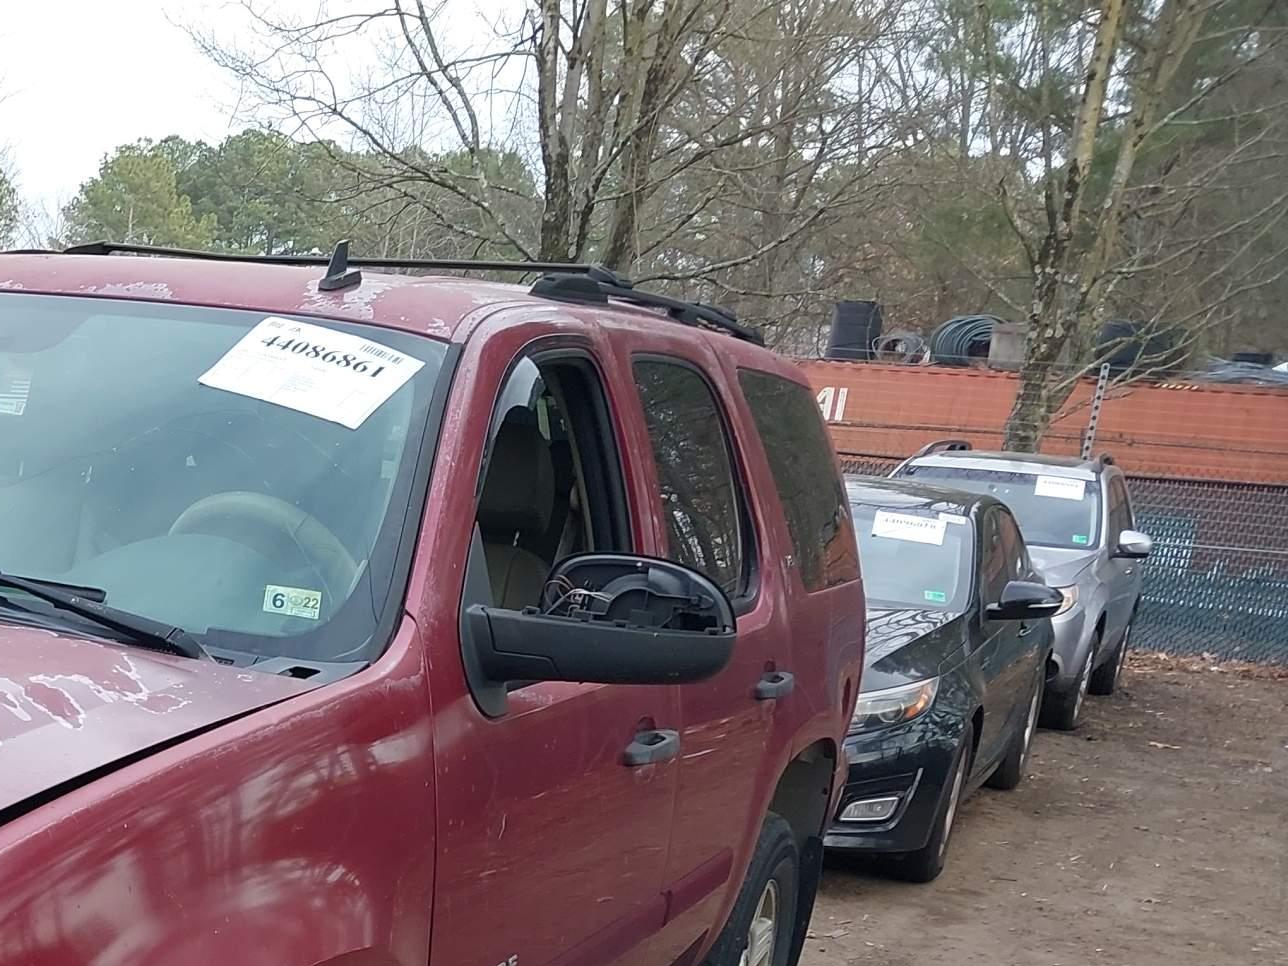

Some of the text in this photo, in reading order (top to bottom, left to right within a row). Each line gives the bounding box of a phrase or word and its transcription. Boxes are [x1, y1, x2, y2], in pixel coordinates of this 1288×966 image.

[261, 335, 386, 378] 44086861
[272, 593, 319, 610] 6 22
